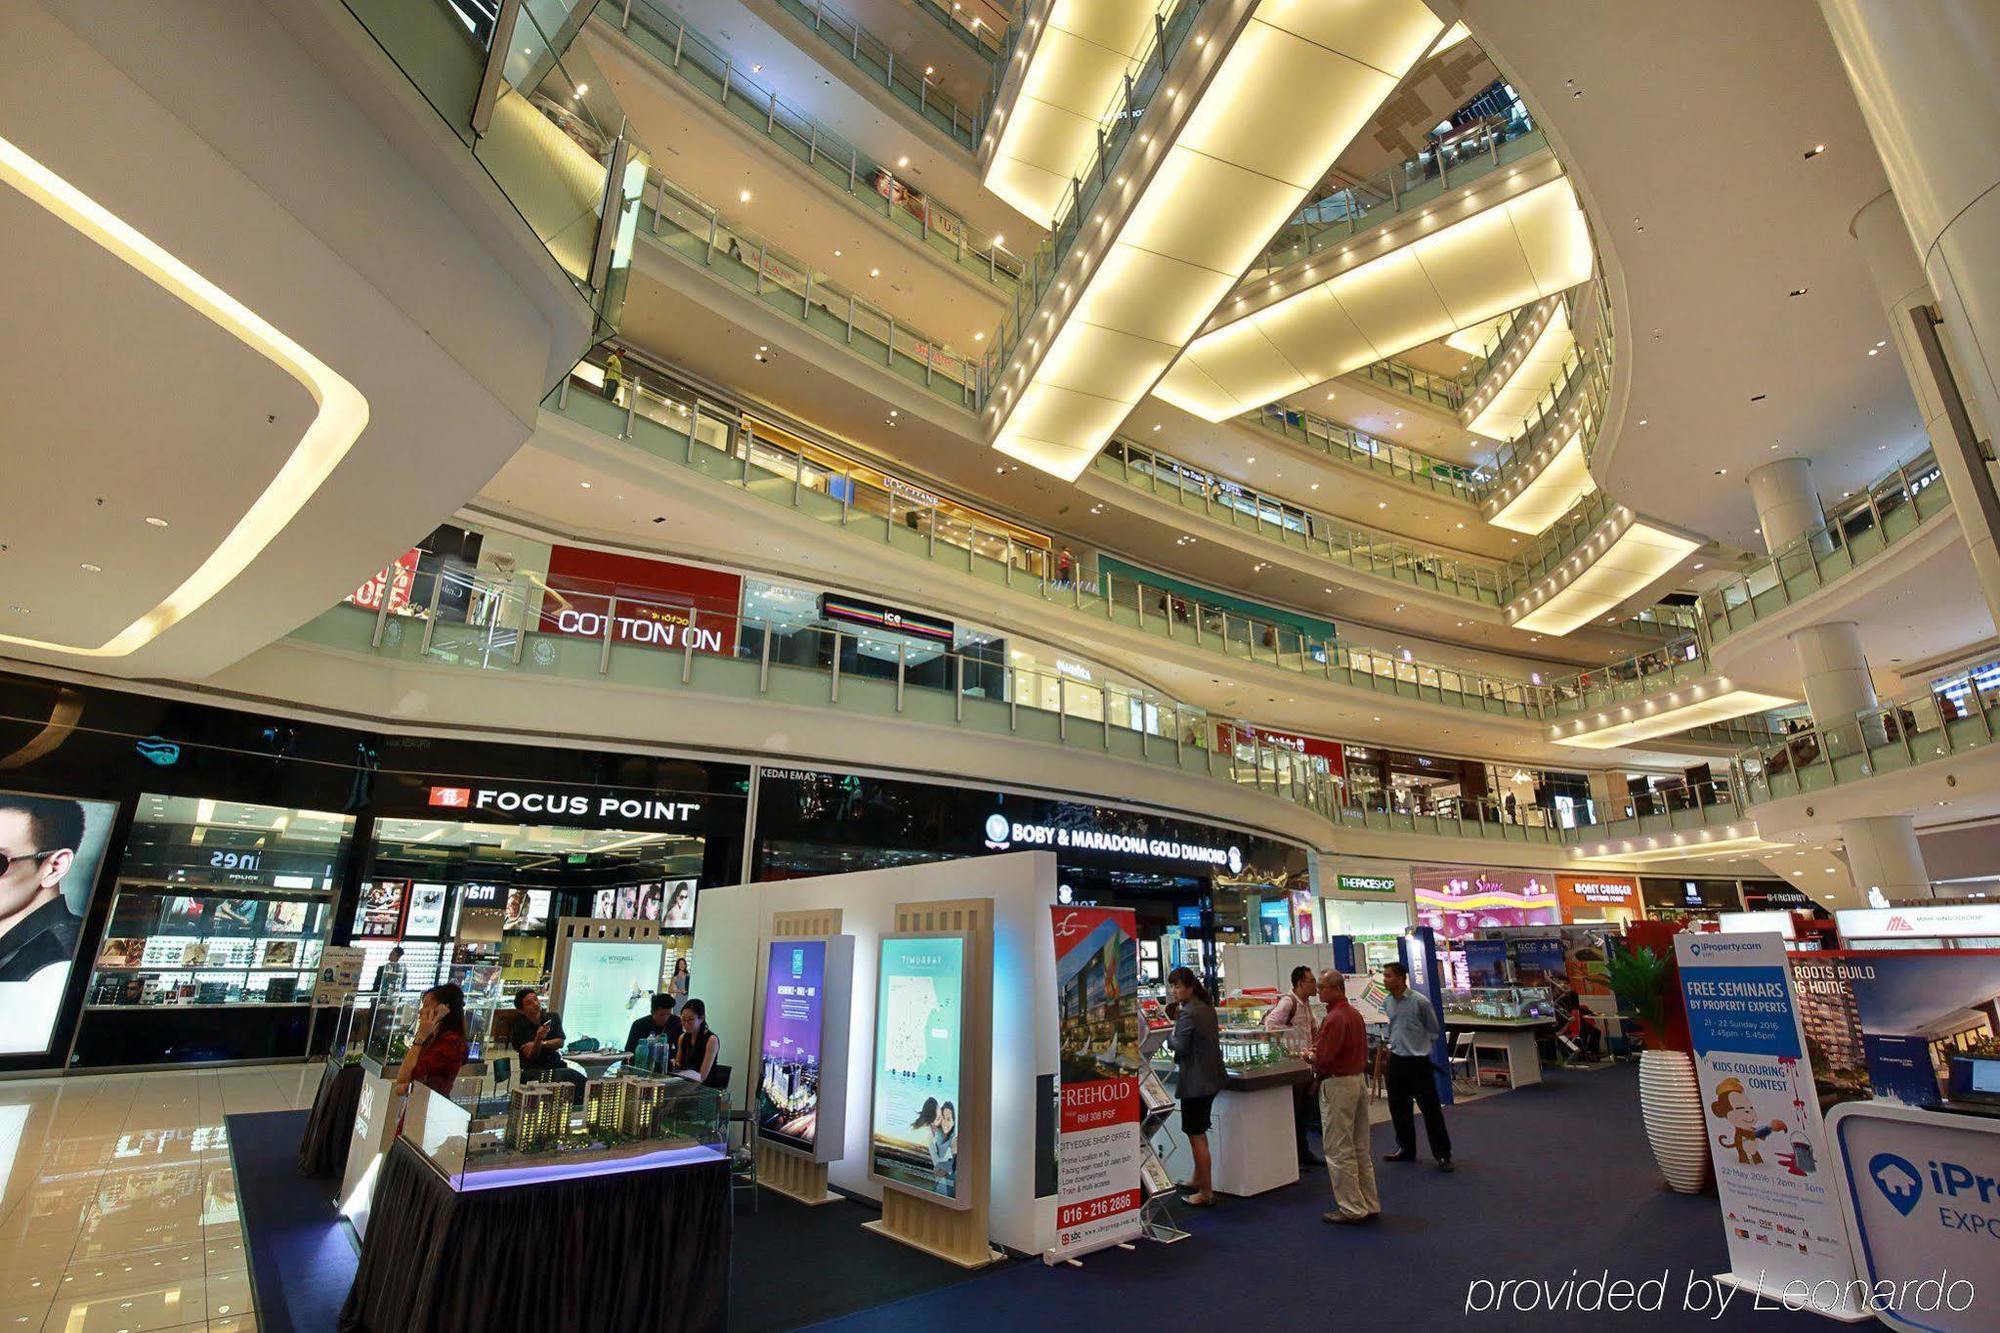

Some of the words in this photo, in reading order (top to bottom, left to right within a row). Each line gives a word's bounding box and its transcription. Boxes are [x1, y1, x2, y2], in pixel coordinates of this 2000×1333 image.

[884, 609, 902, 623] ice
[558, 609, 674, 646] COTTON
[681, 625, 723, 652] ON
[760, 767, 788, 779] KEDAI
[790, 770, 816, 782] EMAS
[475, 789, 589, 816] FOCUS
[598, 796, 697, 821] POINT
[1011, 822, 1056, 845] BOBY
[1057, 828, 1070, 846] &
[1071, 829, 1149, 855] MARADONA
[1150, 838, 1181, 859] GOLD
[1181, 844, 1228, 866] DIAMOND
[1341, 876, 1395, 890] THEFACESHOP
[1574, 882, 1599, 895] MONEY
[1600, 884, 1632, 896] CHANGER
[1700, 942, 1762, 952] iProperty.com
[1794, 965, 1835, 979] ROOTS
[1837, 966, 1876, 980] BUILD
[1687, 982, 1718, 996] FREE
[1718, 982, 1784, 998] SEMINARS
[1810, 981, 1847, 995] HOME
[1690, 999, 1701, 1009] BY
[1703, 1000, 1747, 1011] PROPERTY
[1748, 1001, 1788, 1013] EXPERTS
[1718, 1019, 1728, 1027] 22
[1728, 1020, 1758, 1030] Sunday
[1760, 1021, 1779, 1030] 2016
[1712, 1061, 1734, 1073] KIDS
[1734, 1062, 1785, 1078] COLOURING
[1748, 1077, 1788, 1092] CONTEST
[1061, 1082, 1131, 1107] FREEHOLD
[1092, 1134, 1111, 1146] SHOP
[1111, 1130, 1132, 1142] OFFICE
[1731, 1169, 1749, 1180] May
[1776, 1177, 1796, 1189] 2pm
[1805, 1182, 1825, 1194] 3pm
[1928, 1160, 2000, 1204] iPr
[1063, 1207, 1083, 1224] 016
[1090, 1200, 1108, 1217] 216
[1109, 1194, 1131, 1212] 2886
[1070, 1231, 1081, 1241] sbc
